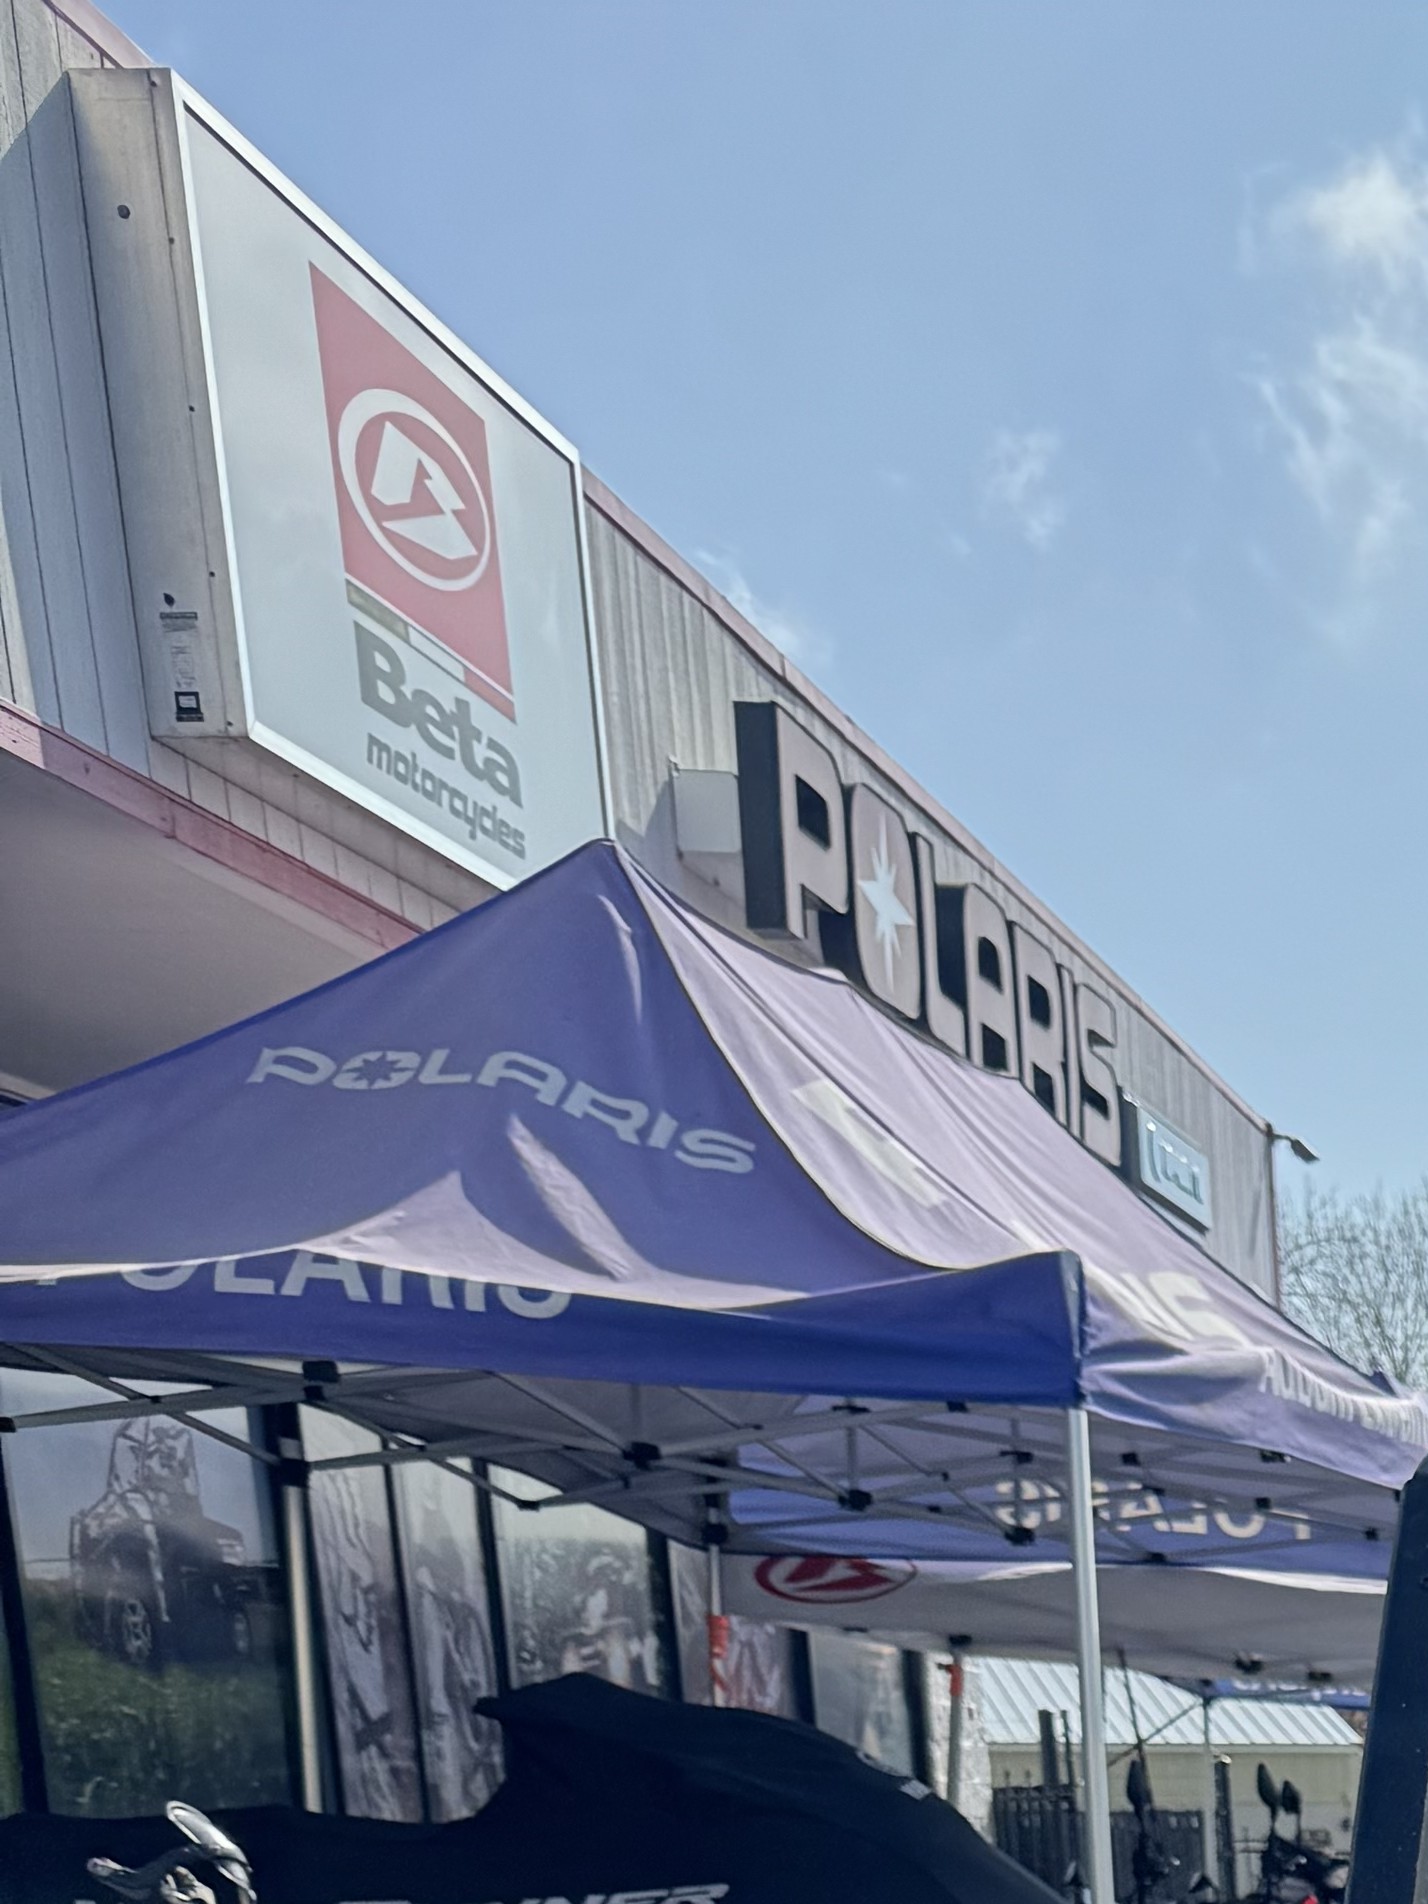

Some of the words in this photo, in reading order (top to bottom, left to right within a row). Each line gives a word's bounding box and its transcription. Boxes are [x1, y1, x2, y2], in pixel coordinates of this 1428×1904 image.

[354, 620, 523, 809] Beta
[367, 732, 526, 860] motorcycles
[736, 700, 1122, 1168] POLARIS
[246, 1047, 757, 1174] POLARIS
